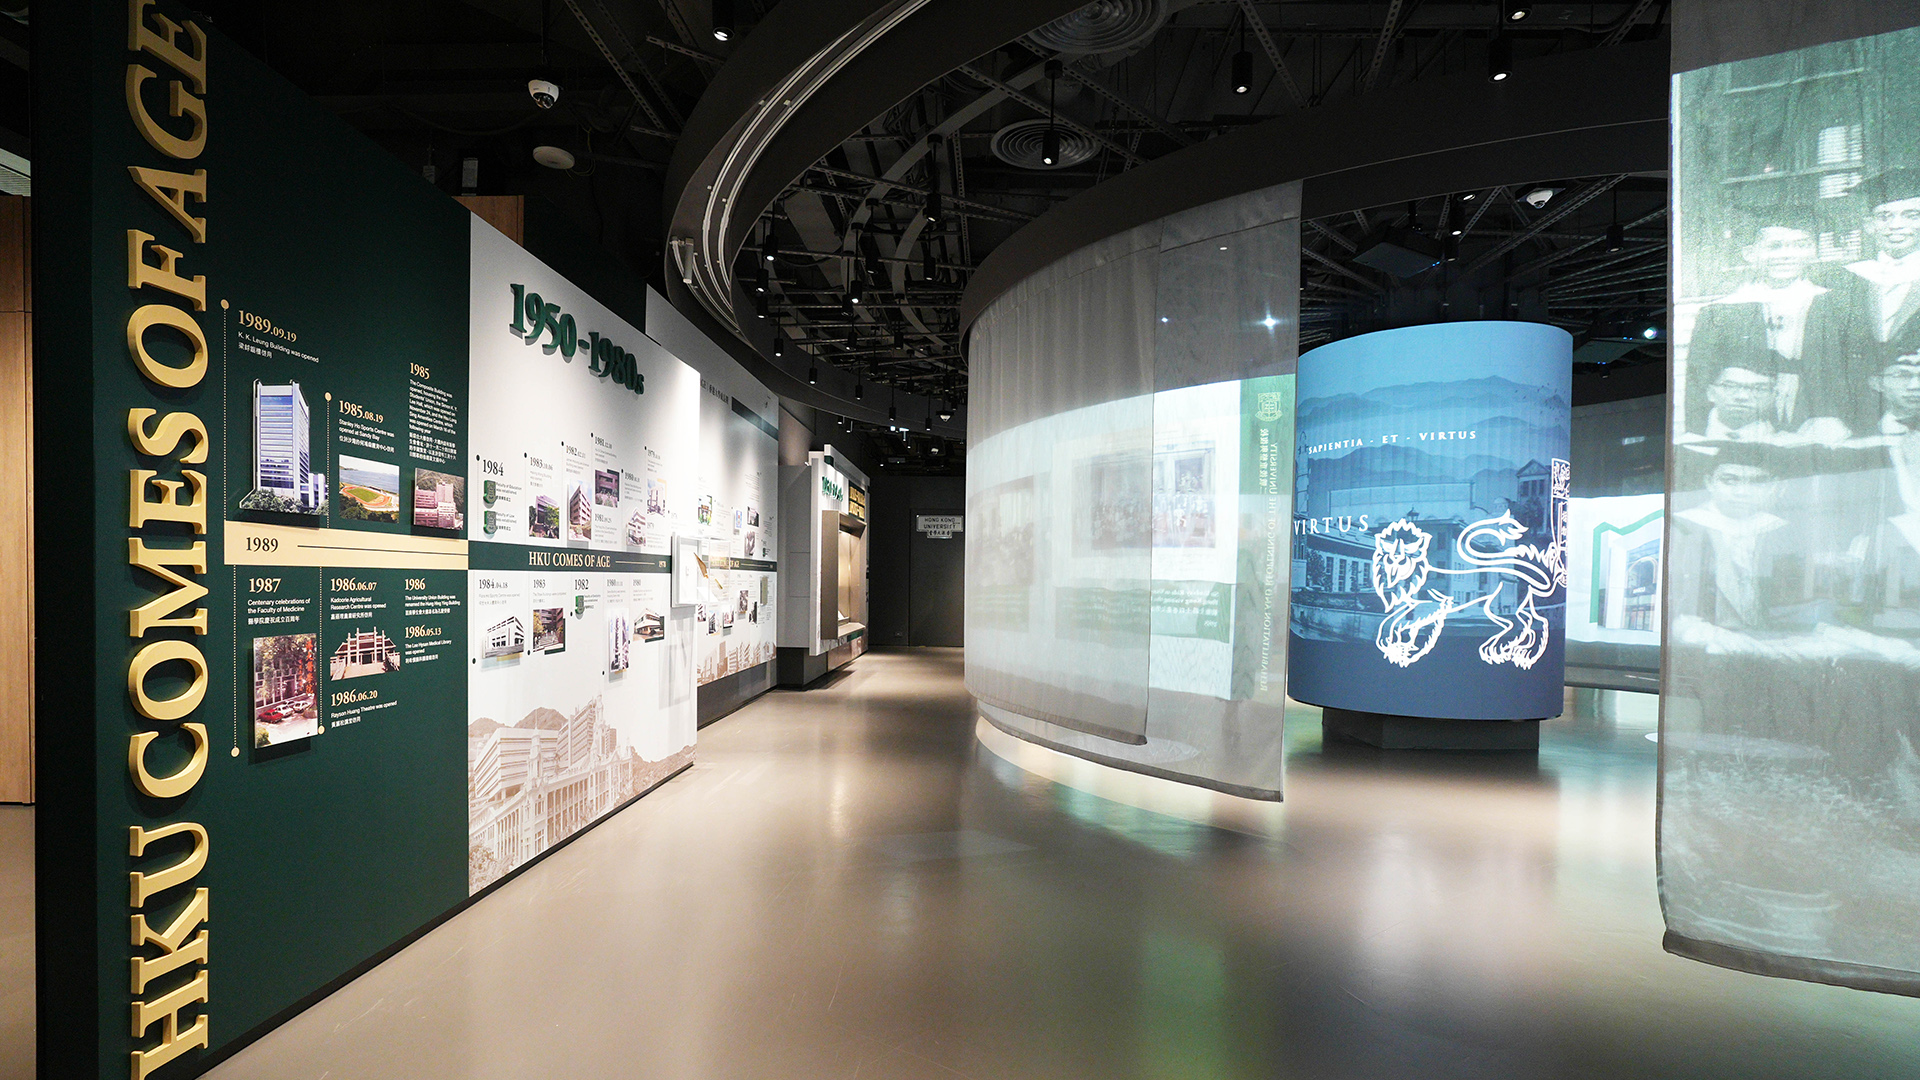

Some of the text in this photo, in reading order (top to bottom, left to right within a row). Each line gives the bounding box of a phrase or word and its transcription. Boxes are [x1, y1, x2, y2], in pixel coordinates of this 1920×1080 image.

[239, 310, 297, 342] 1989.09.19
[509, 283, 645, 395] 1950-1980s
[252, 336, 269, 348] Leung
[270, 342, 290, 354] Building
[301, 353, 319, 363] opened
[410, 362, 430, 380] 1985
[339, 400, 384, 423] 1985.08.19
[1308, 438, 1363, 454] SAPIENTIA
[1382, 434, 1398, 443] ET
[1419, 431, 1476, 441] VIRTUS
[483, 460, 504, 476] 1984
[1294, 515, 1369, 535] VIRTUS
[125, 0, 209, 1080] HKU COMES OF AGE
[246, 537, 278, 553] 1989
[529, 551, 611, 568] HKU COMES OF AGE
[249, 578, 282, 593] 1987
[331, 577, 377, 592] 1986.06.07
[405, 578, 426, 591] 1986
[533, 579, 546, 589] 1983
[575, 579, 588, 590] 1982
[405, 624, 442, 639] 1986.05.13
[331, 688, 378, 706] 1986.06.20
